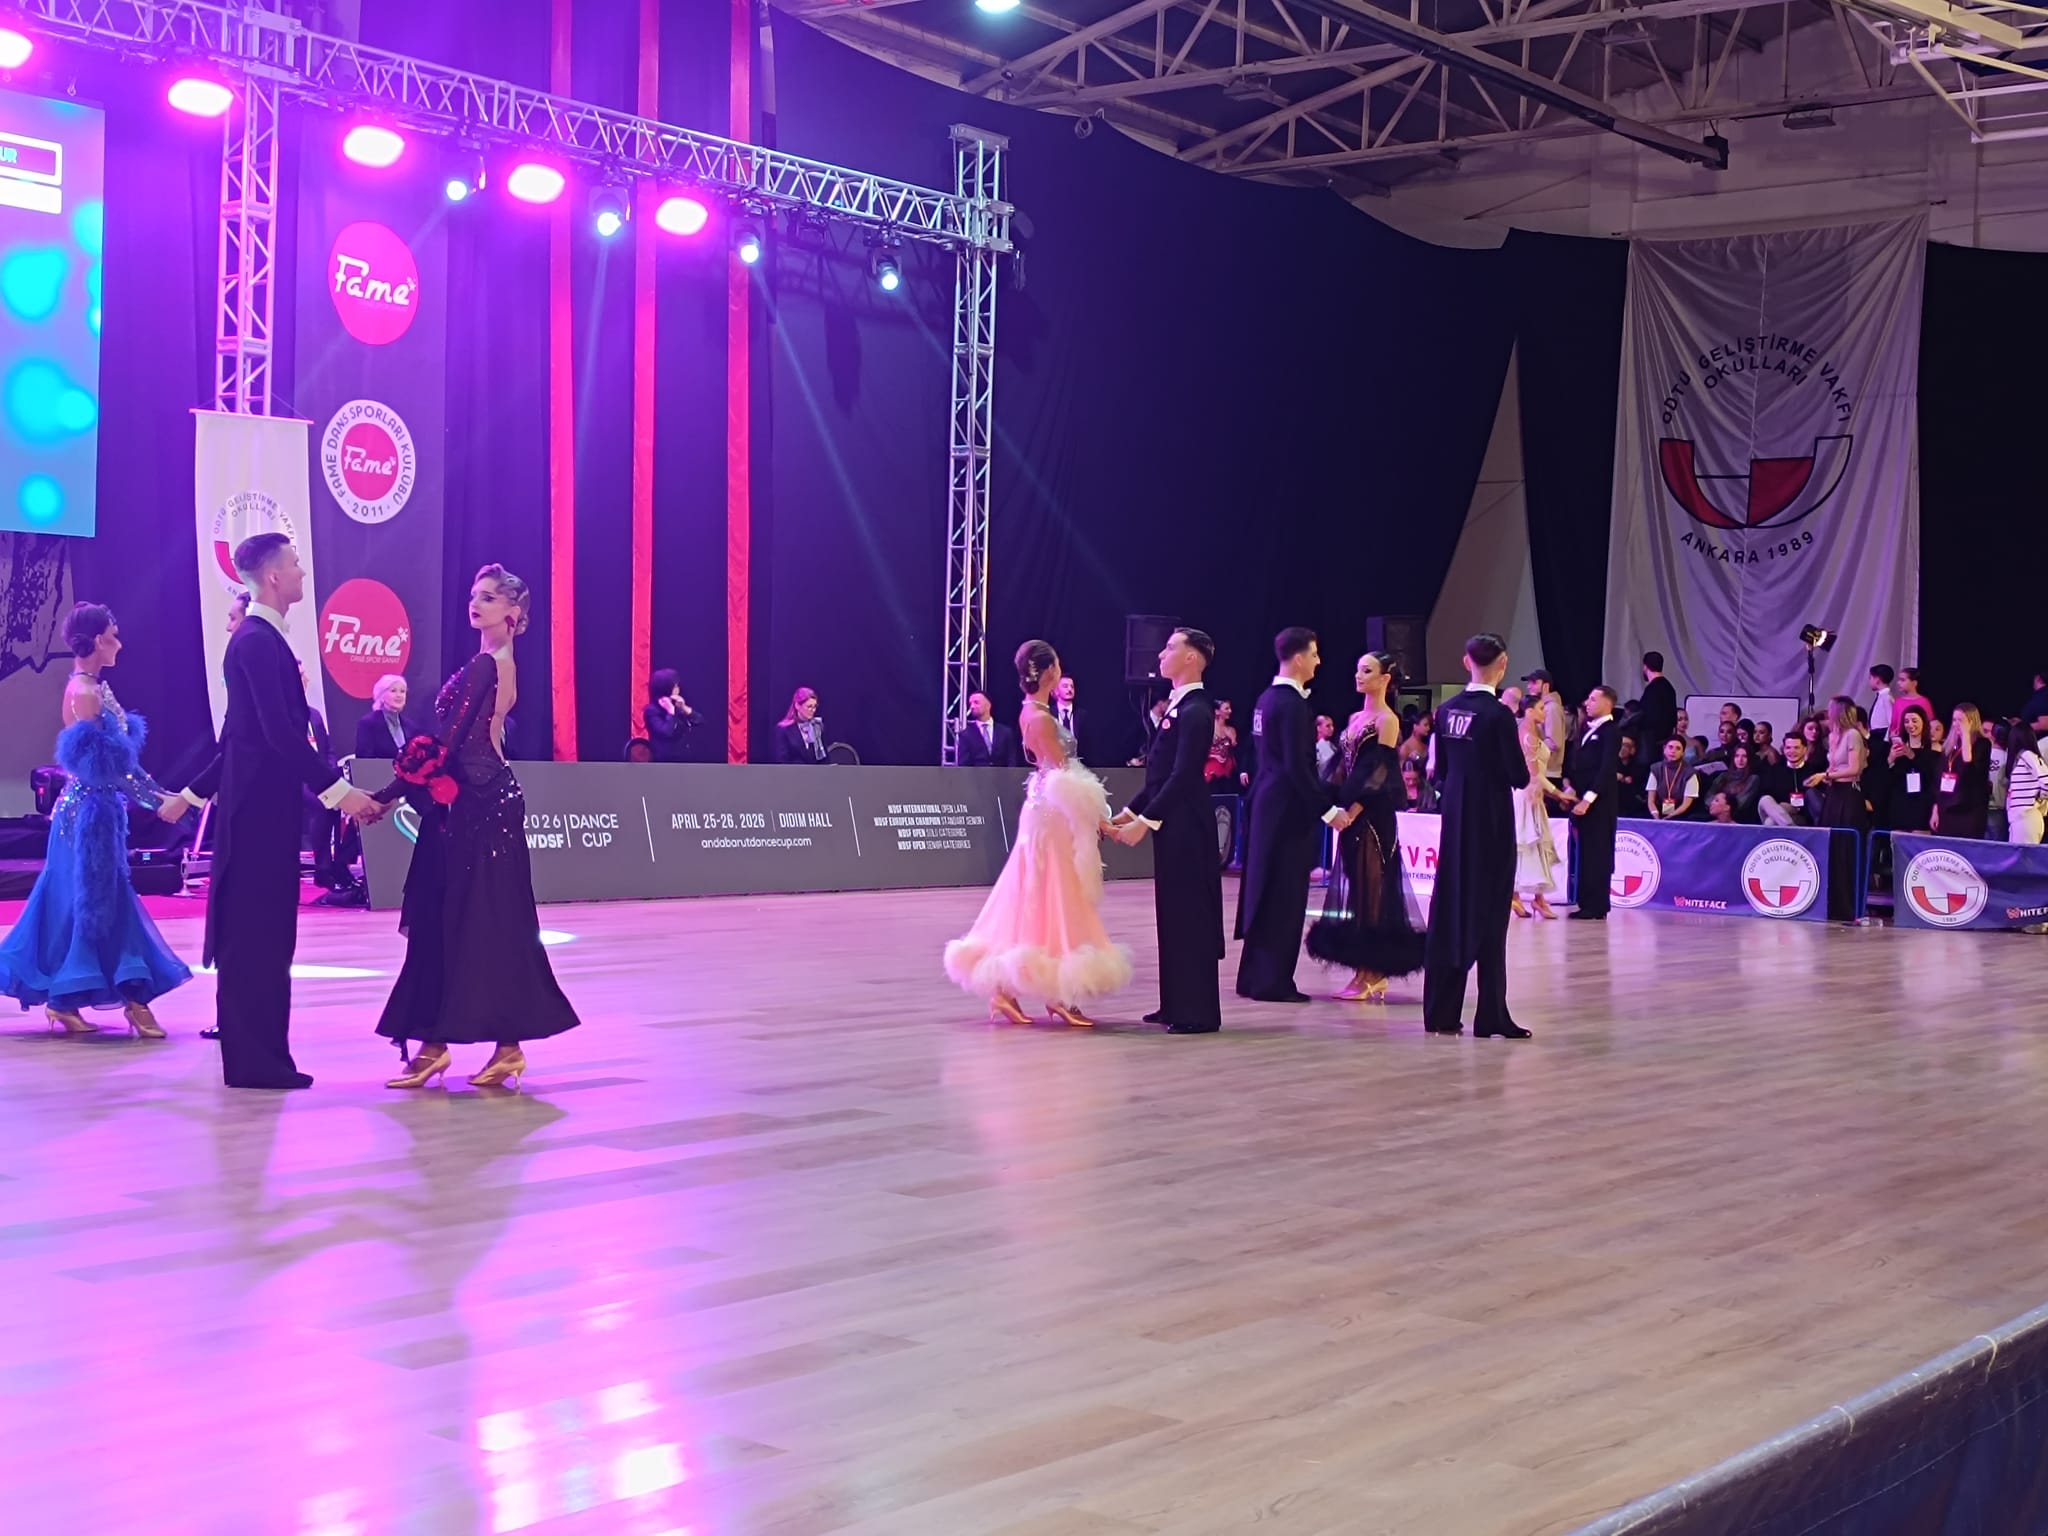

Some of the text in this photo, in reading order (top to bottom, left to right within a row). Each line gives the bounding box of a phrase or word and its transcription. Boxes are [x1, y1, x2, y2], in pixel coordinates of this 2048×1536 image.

[335, 253, 411, 306] Fame
[1703, 355, 1808, 390] OKULLARI
[327, 411, 350, 450] DANS
[326, 453, 346, 498] FAME
[343, 445, 393, 476] Fame
[352, 502, 384, 518] 2011
[1680, 530, 1814, 564] ANKARA 1989
[324, 613, 402, 657] Fame
[1447, 715, 1473, 736] 107
[523, 813, 619, 829] 2026 DANCE
[671, 812, 833, 829] APRIL 25-26, 2026 DIDIM HALL
[525, 832, 612, 849] WDSF CUP
[701, 836, 812, 849] andabarutdancecup.com
